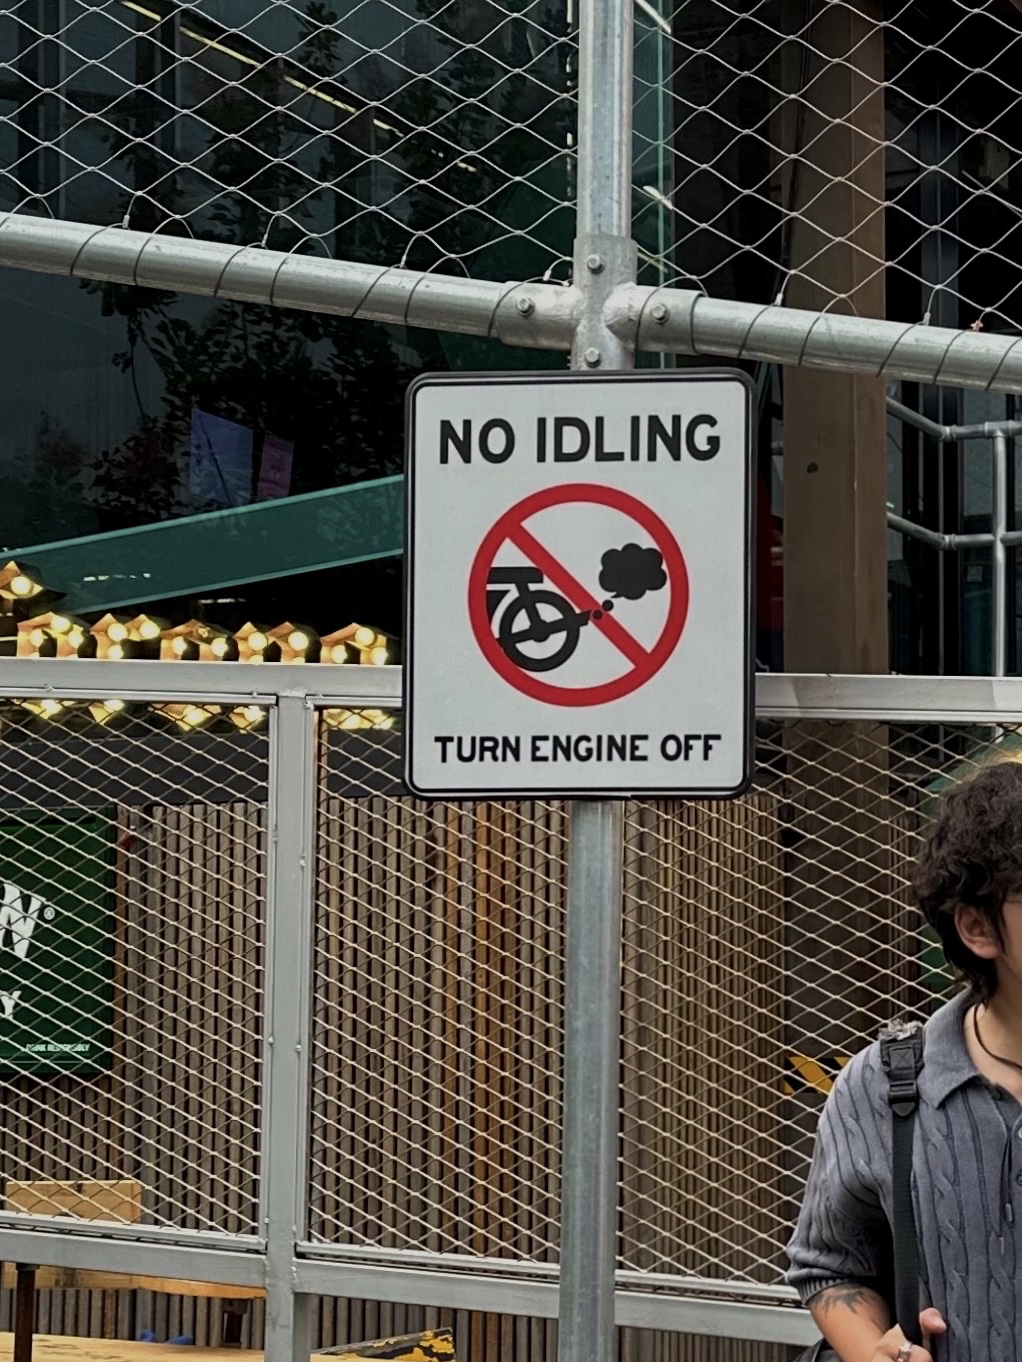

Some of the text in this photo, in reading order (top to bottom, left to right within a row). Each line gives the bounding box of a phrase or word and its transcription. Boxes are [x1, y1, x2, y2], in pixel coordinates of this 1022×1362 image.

[439, 414, 721, 464] NO IDLING
[434, 734, 722, 763] TURN ENGINE OFF
